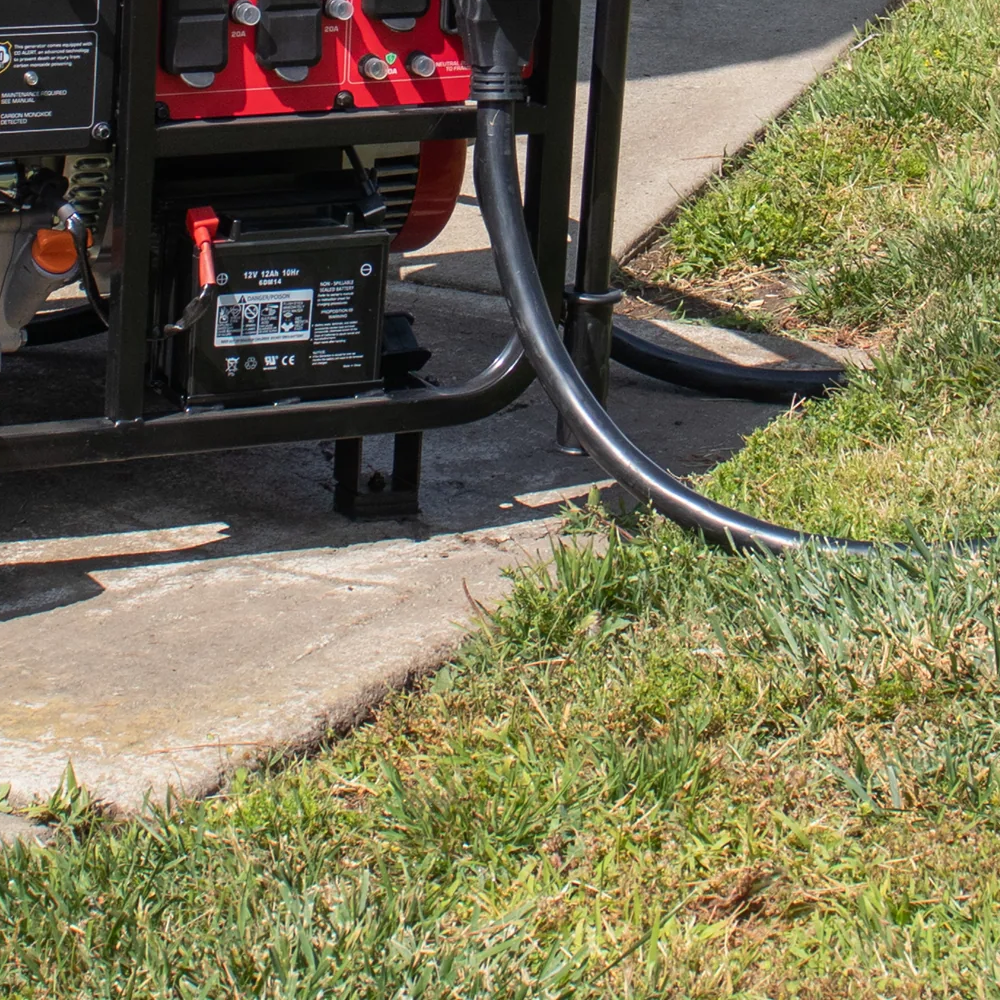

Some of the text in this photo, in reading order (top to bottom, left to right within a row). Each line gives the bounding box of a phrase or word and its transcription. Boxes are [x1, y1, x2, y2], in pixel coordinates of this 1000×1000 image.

[244, 268, 300, 280] 12V 12Ah 10Hr
